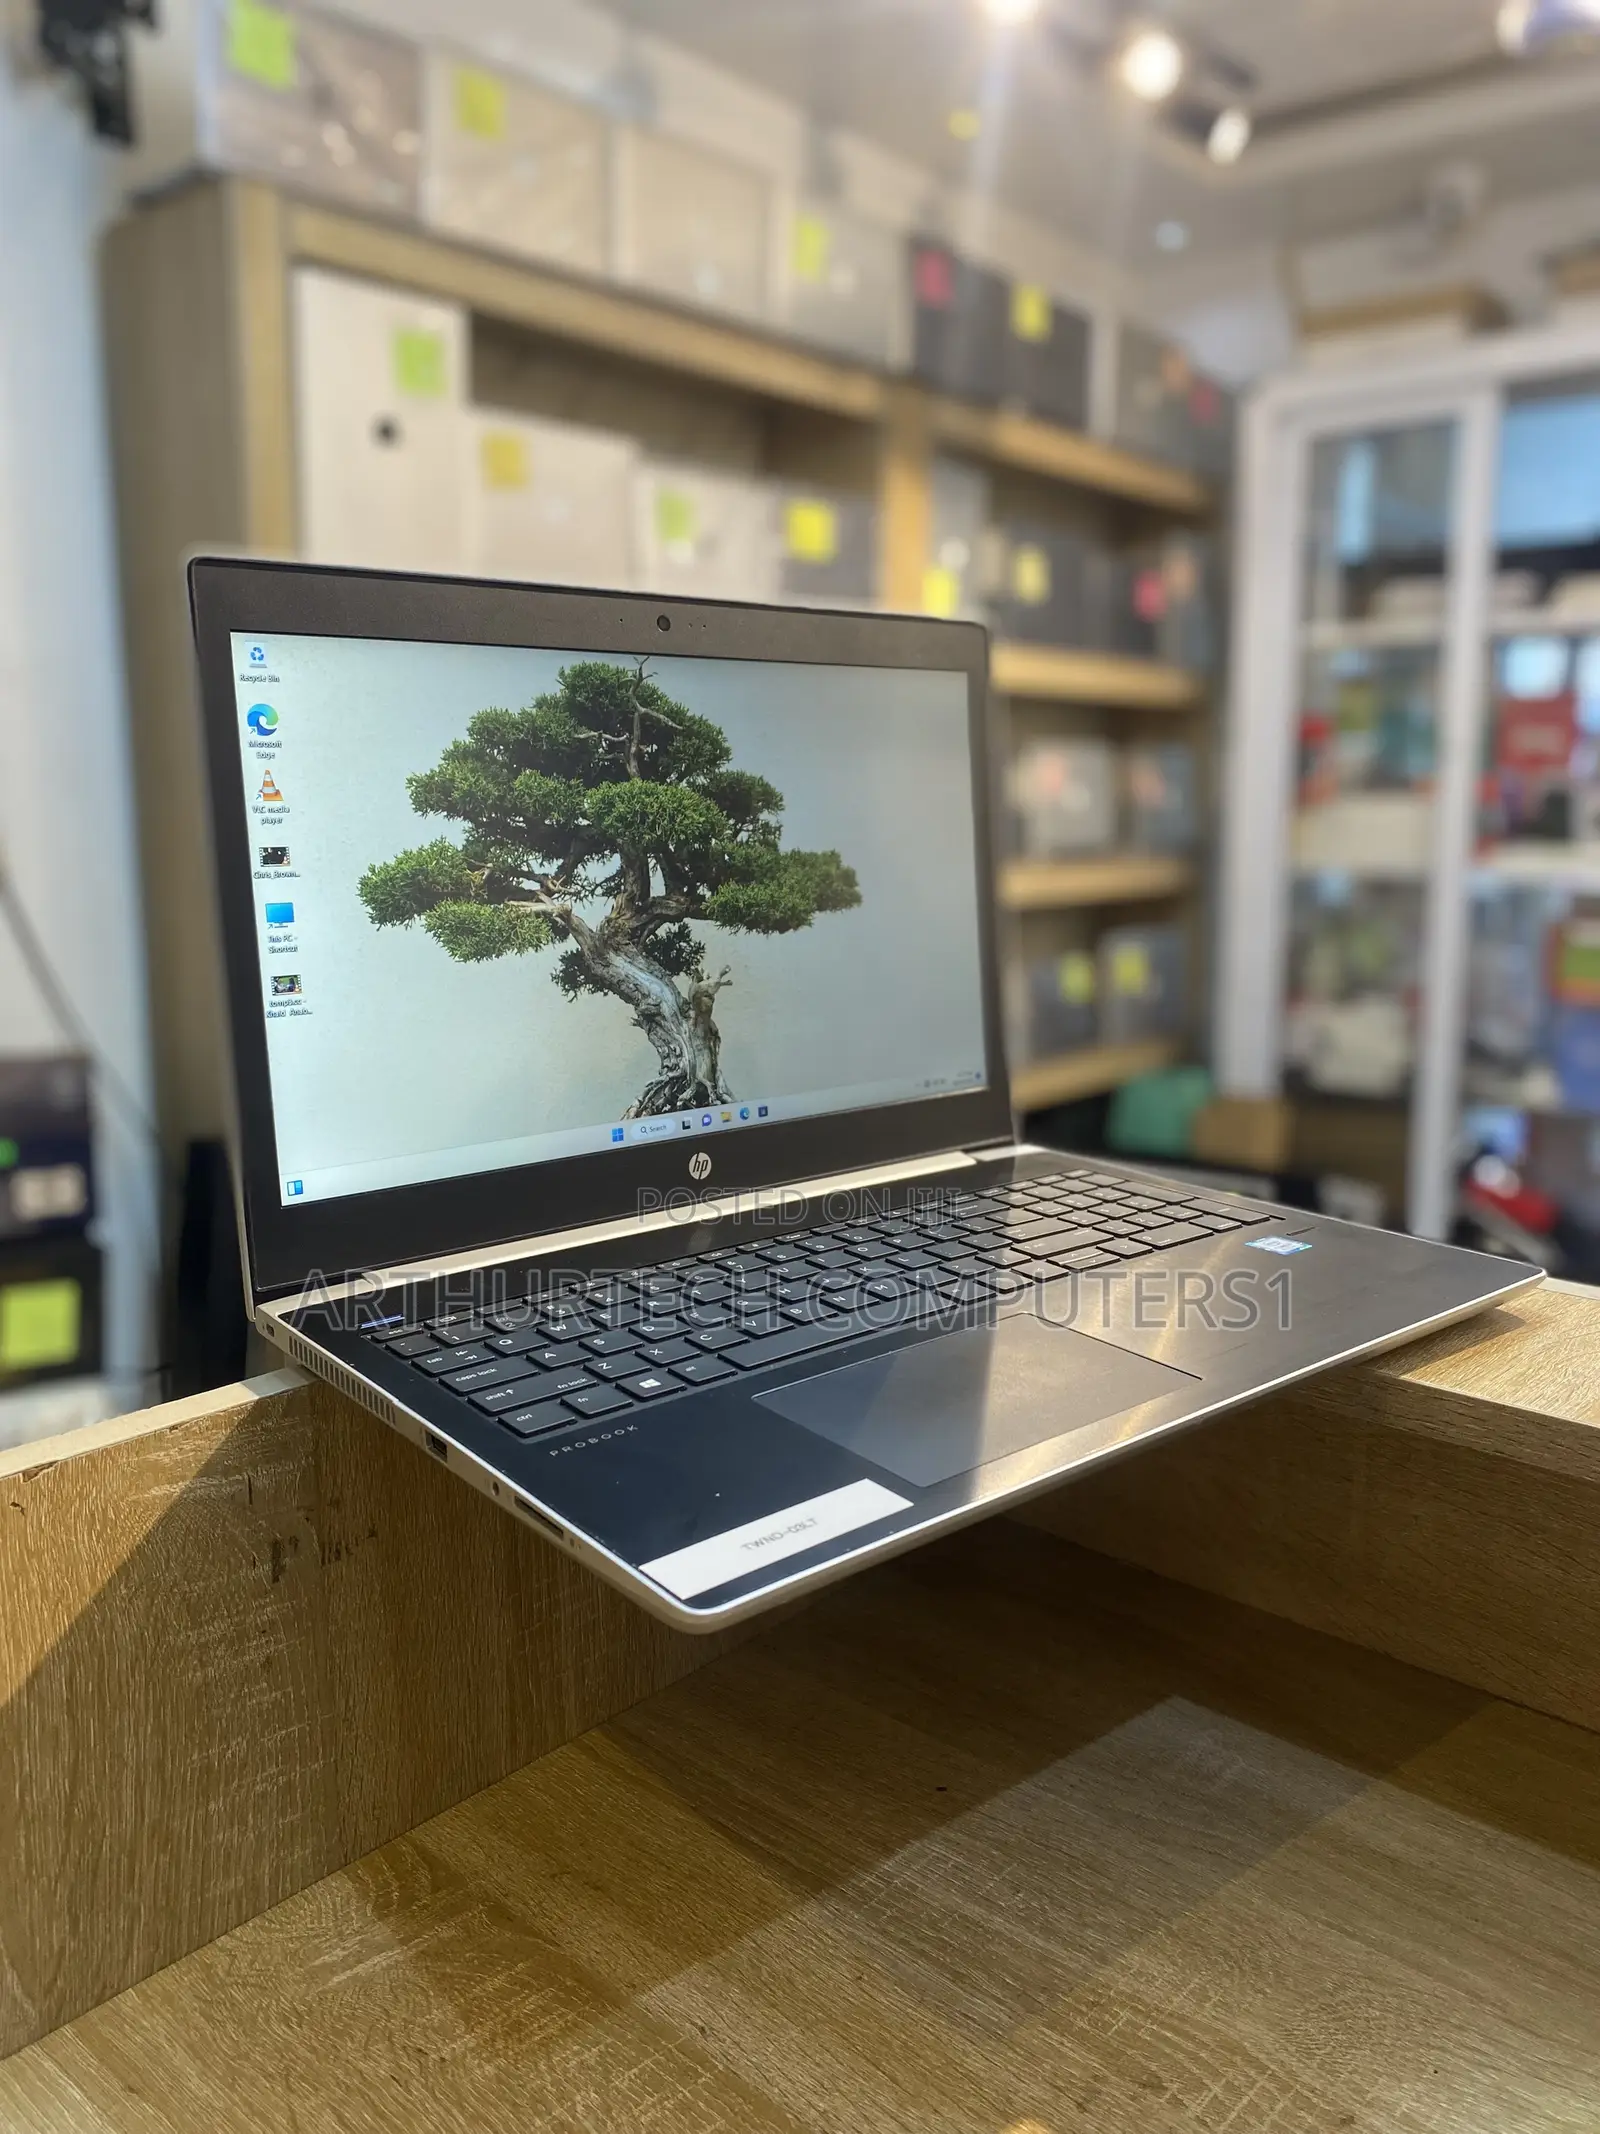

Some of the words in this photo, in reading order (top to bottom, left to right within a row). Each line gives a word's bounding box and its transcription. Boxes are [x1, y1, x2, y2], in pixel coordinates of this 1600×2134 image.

[240, 674, 266, 683] Recycle
[256, 751, 275, 760] Edge
[649, 1124, 667, 1133] Search
[689, 1152, 711, 1180] hp
[550, 1323, 567, 1332] W
[499, 1338, 514, 1346] Q
[649, 1348, 664, 1356] X
[597, 1362, 612, 1370] Z
[455, 1373, 477, 1382] caps
[477, 1367, 498, 1377] lock
[568, 1377, 588, 1387] lock
[485, 1391, 506, 1401] shift
[516, 1413, 533, 1422] ctrl
[549, 1424, 639, 1457] PROBOOK
